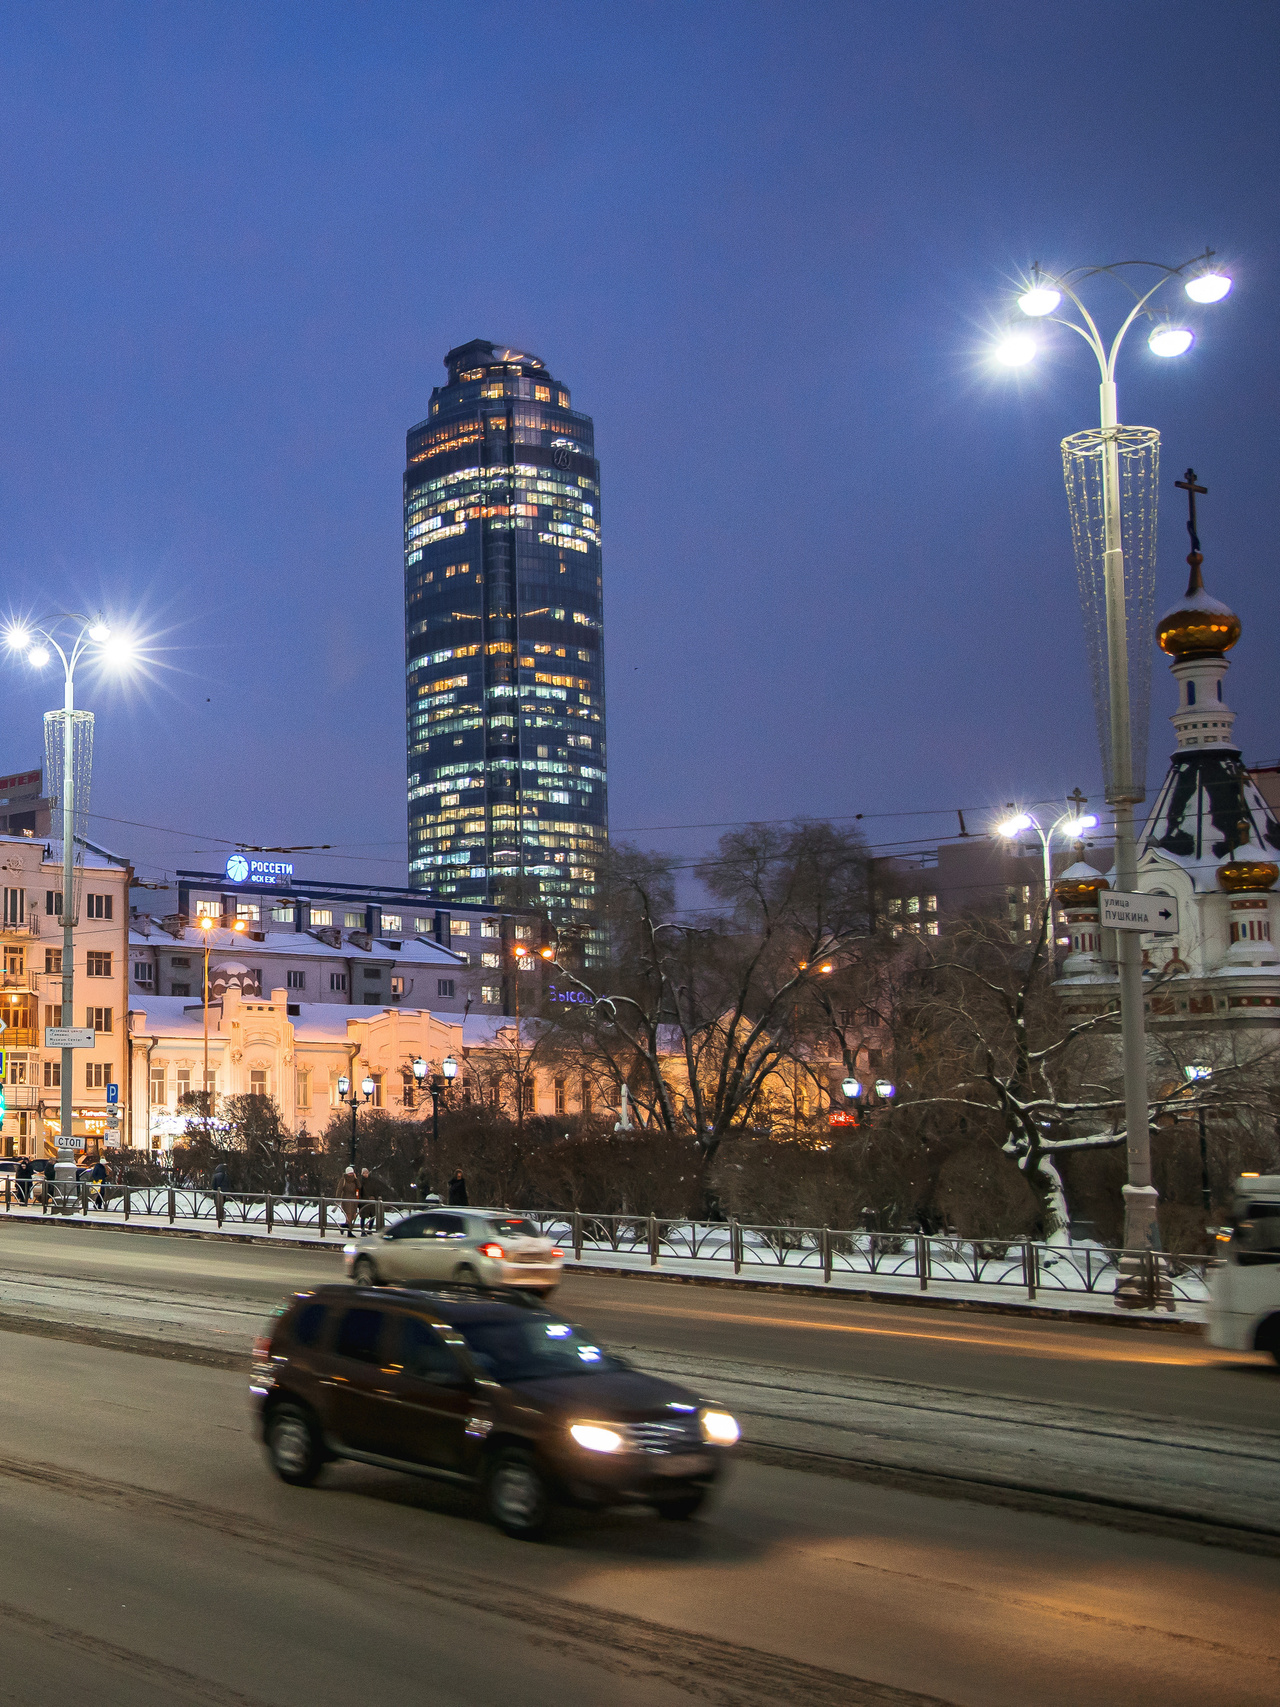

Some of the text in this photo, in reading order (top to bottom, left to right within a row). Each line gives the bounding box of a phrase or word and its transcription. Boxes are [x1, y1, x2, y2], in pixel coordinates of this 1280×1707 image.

[251, 861, 293, 874] РОССЕТИ
[251, 875, 264, 883] ФСК
[1104, 899, 1129, 908] улица
[1105, 910, 1149, 923] ПУШКИНА
[58, 1137, 81, 1147] СТОП
